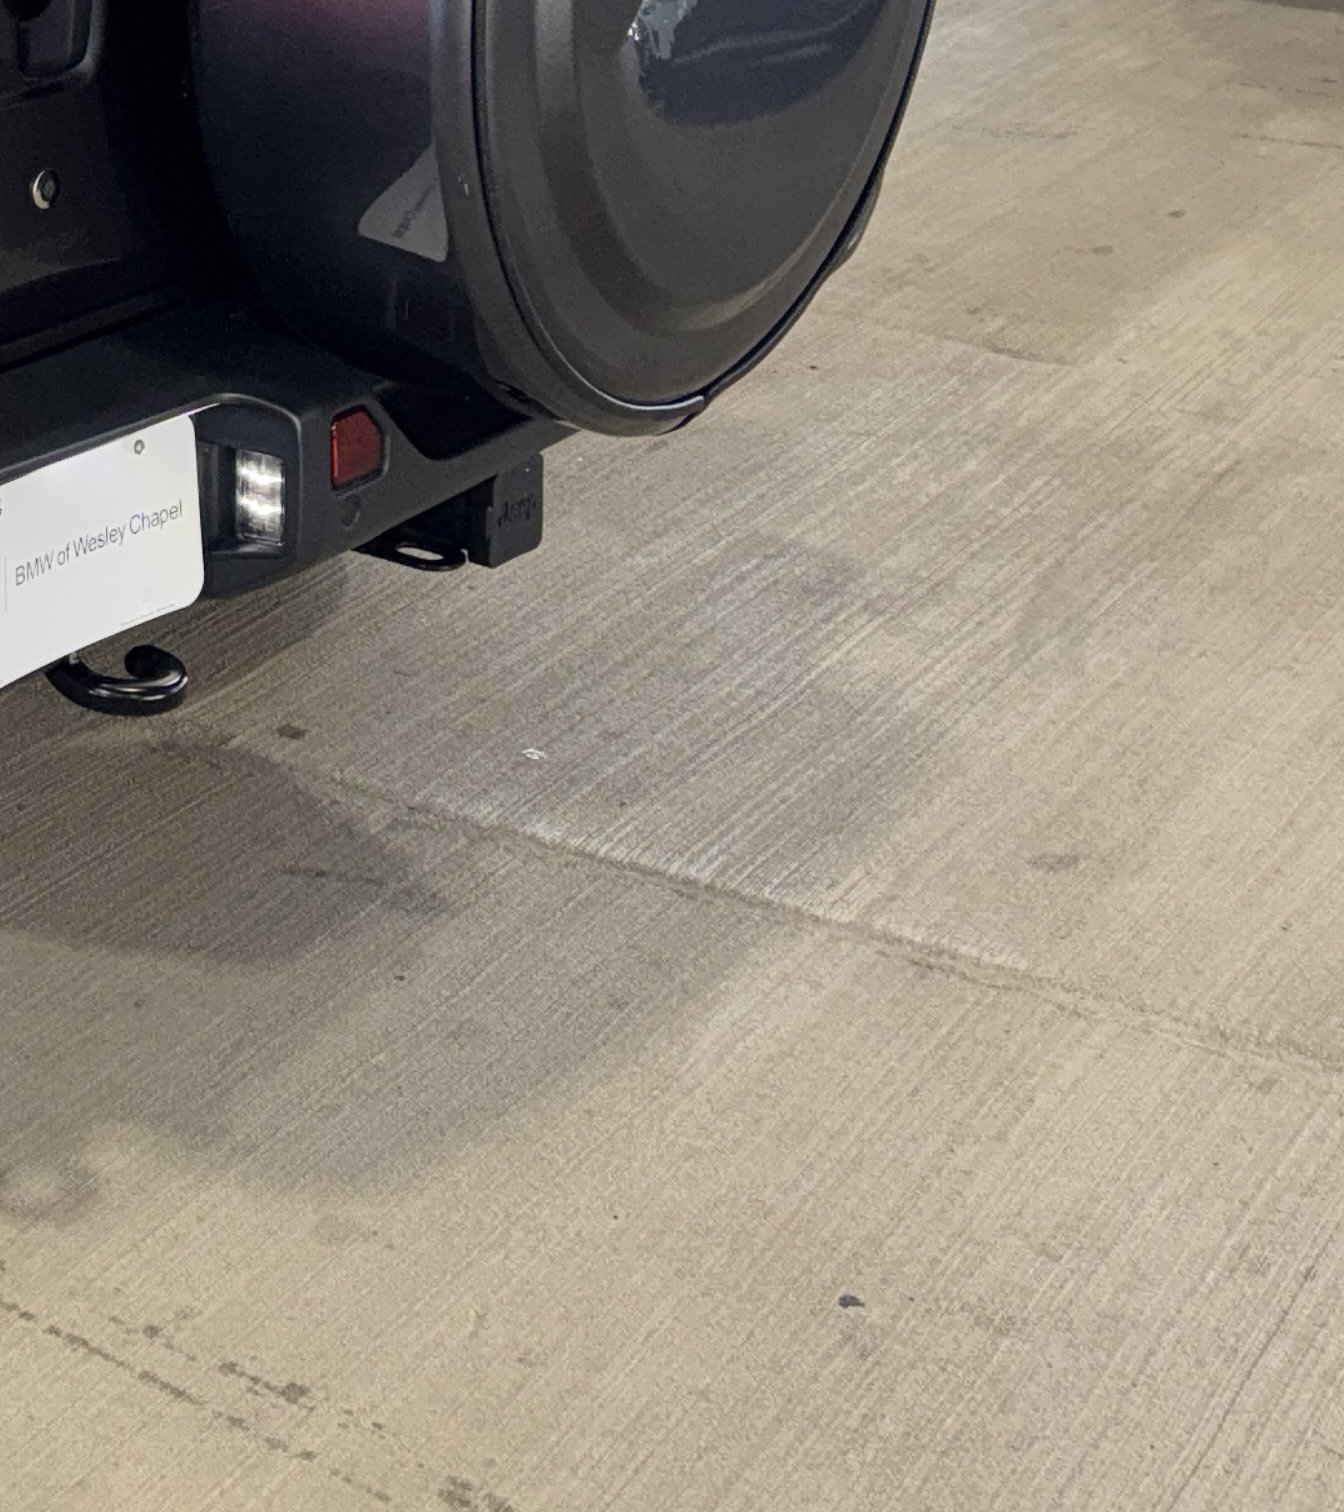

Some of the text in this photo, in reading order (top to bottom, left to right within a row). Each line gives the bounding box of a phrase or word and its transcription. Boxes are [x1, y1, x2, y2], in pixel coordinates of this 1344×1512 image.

[15, 498, 183, 586] BMW of Wesley Chapel
